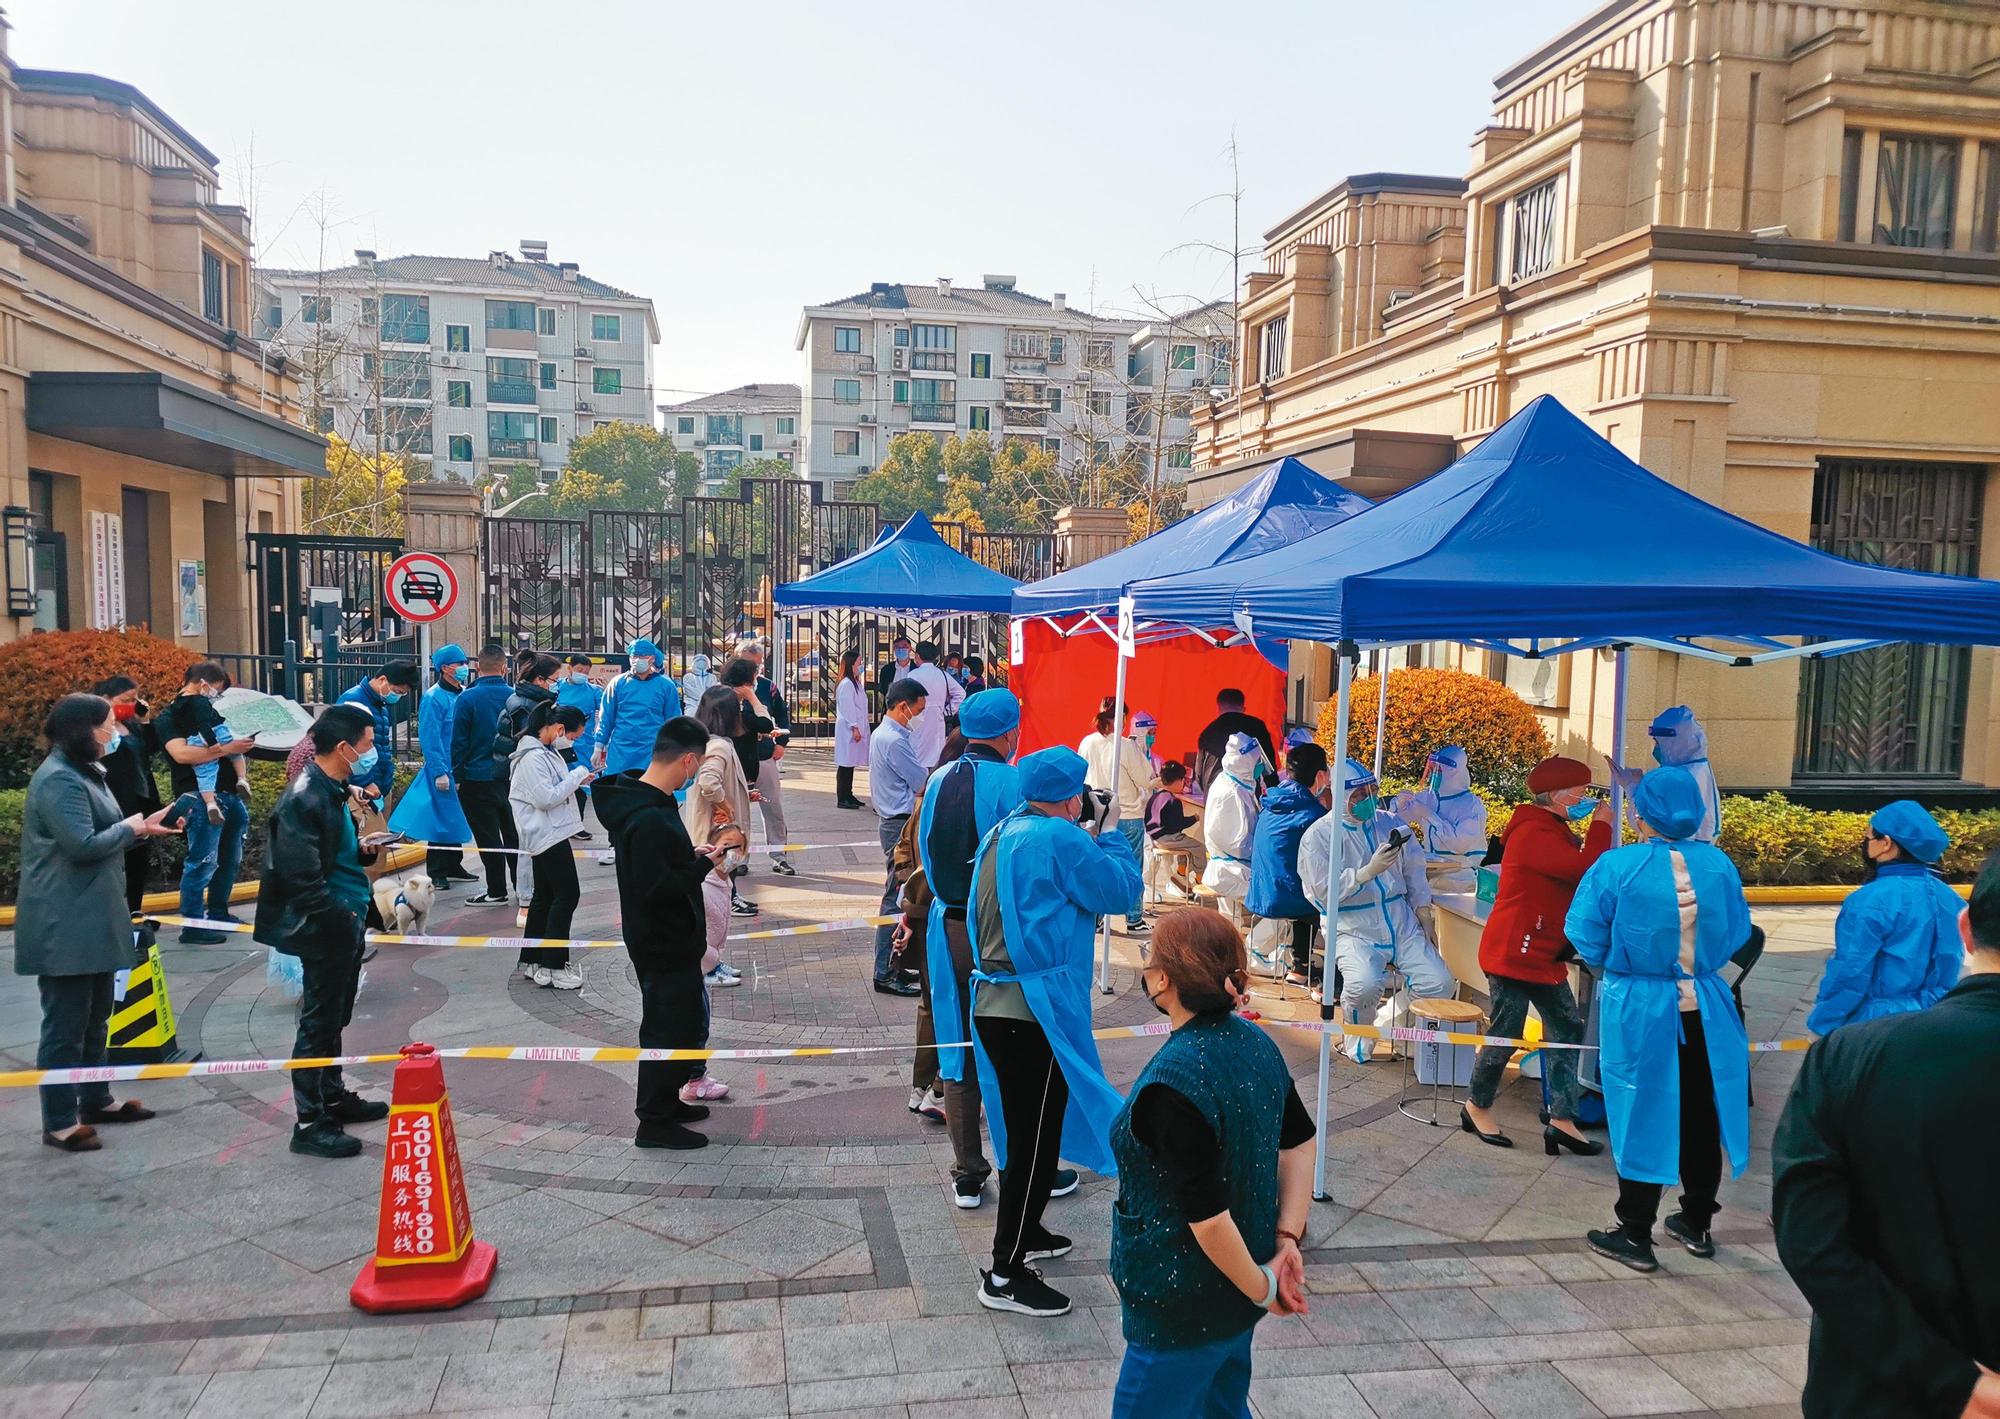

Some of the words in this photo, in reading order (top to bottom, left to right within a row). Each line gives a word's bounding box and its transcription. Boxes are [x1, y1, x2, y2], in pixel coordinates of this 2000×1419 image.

[1122, 611, 1130, 641] 2
[1014, 632, 1020, 653] 1
[490, 938, 532, 948] LIMITLINE
[524, 1048, 581, 1060] LIMITLINE
[390, 1117, 415, 1254] 上门服务热线
[413, 1115, 435, 1254] 4001691900
